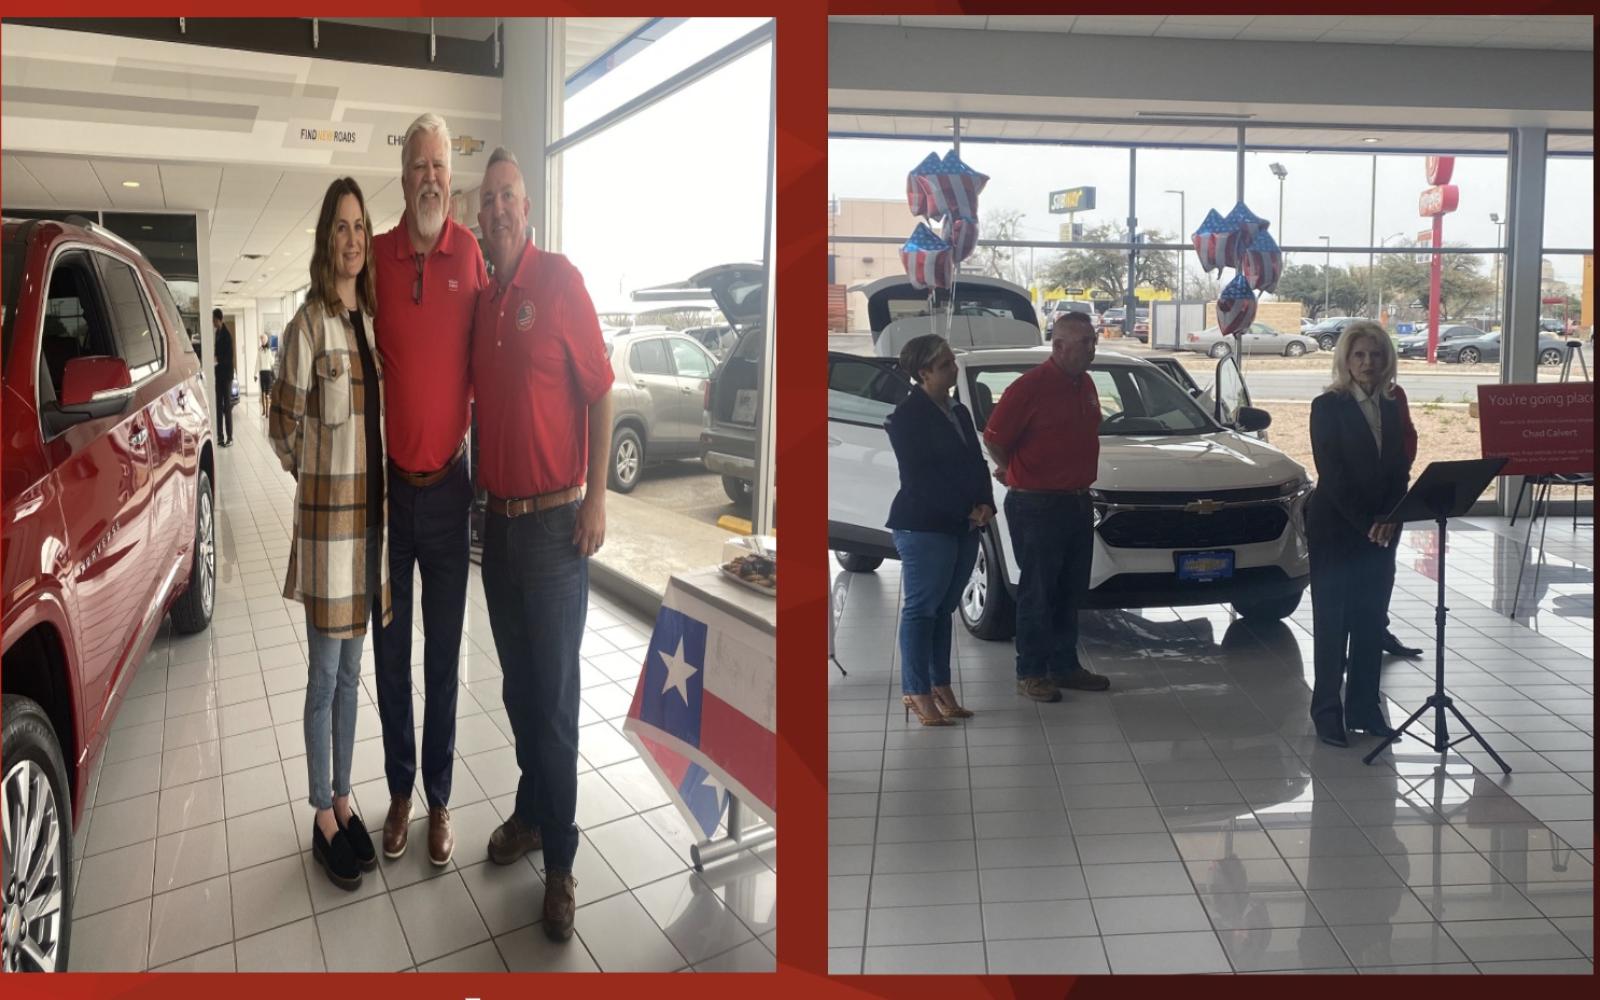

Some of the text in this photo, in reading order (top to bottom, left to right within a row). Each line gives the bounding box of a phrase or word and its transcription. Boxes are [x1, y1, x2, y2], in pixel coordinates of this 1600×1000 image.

[301, 129, 317, 140] FIND
[333, 131, 356, 143] ROADS
[1489, 393, 1527, 406] You're
[1530, 394, 1564, 408] going
[1522, 427, 1578, 438] Chad Calvert
